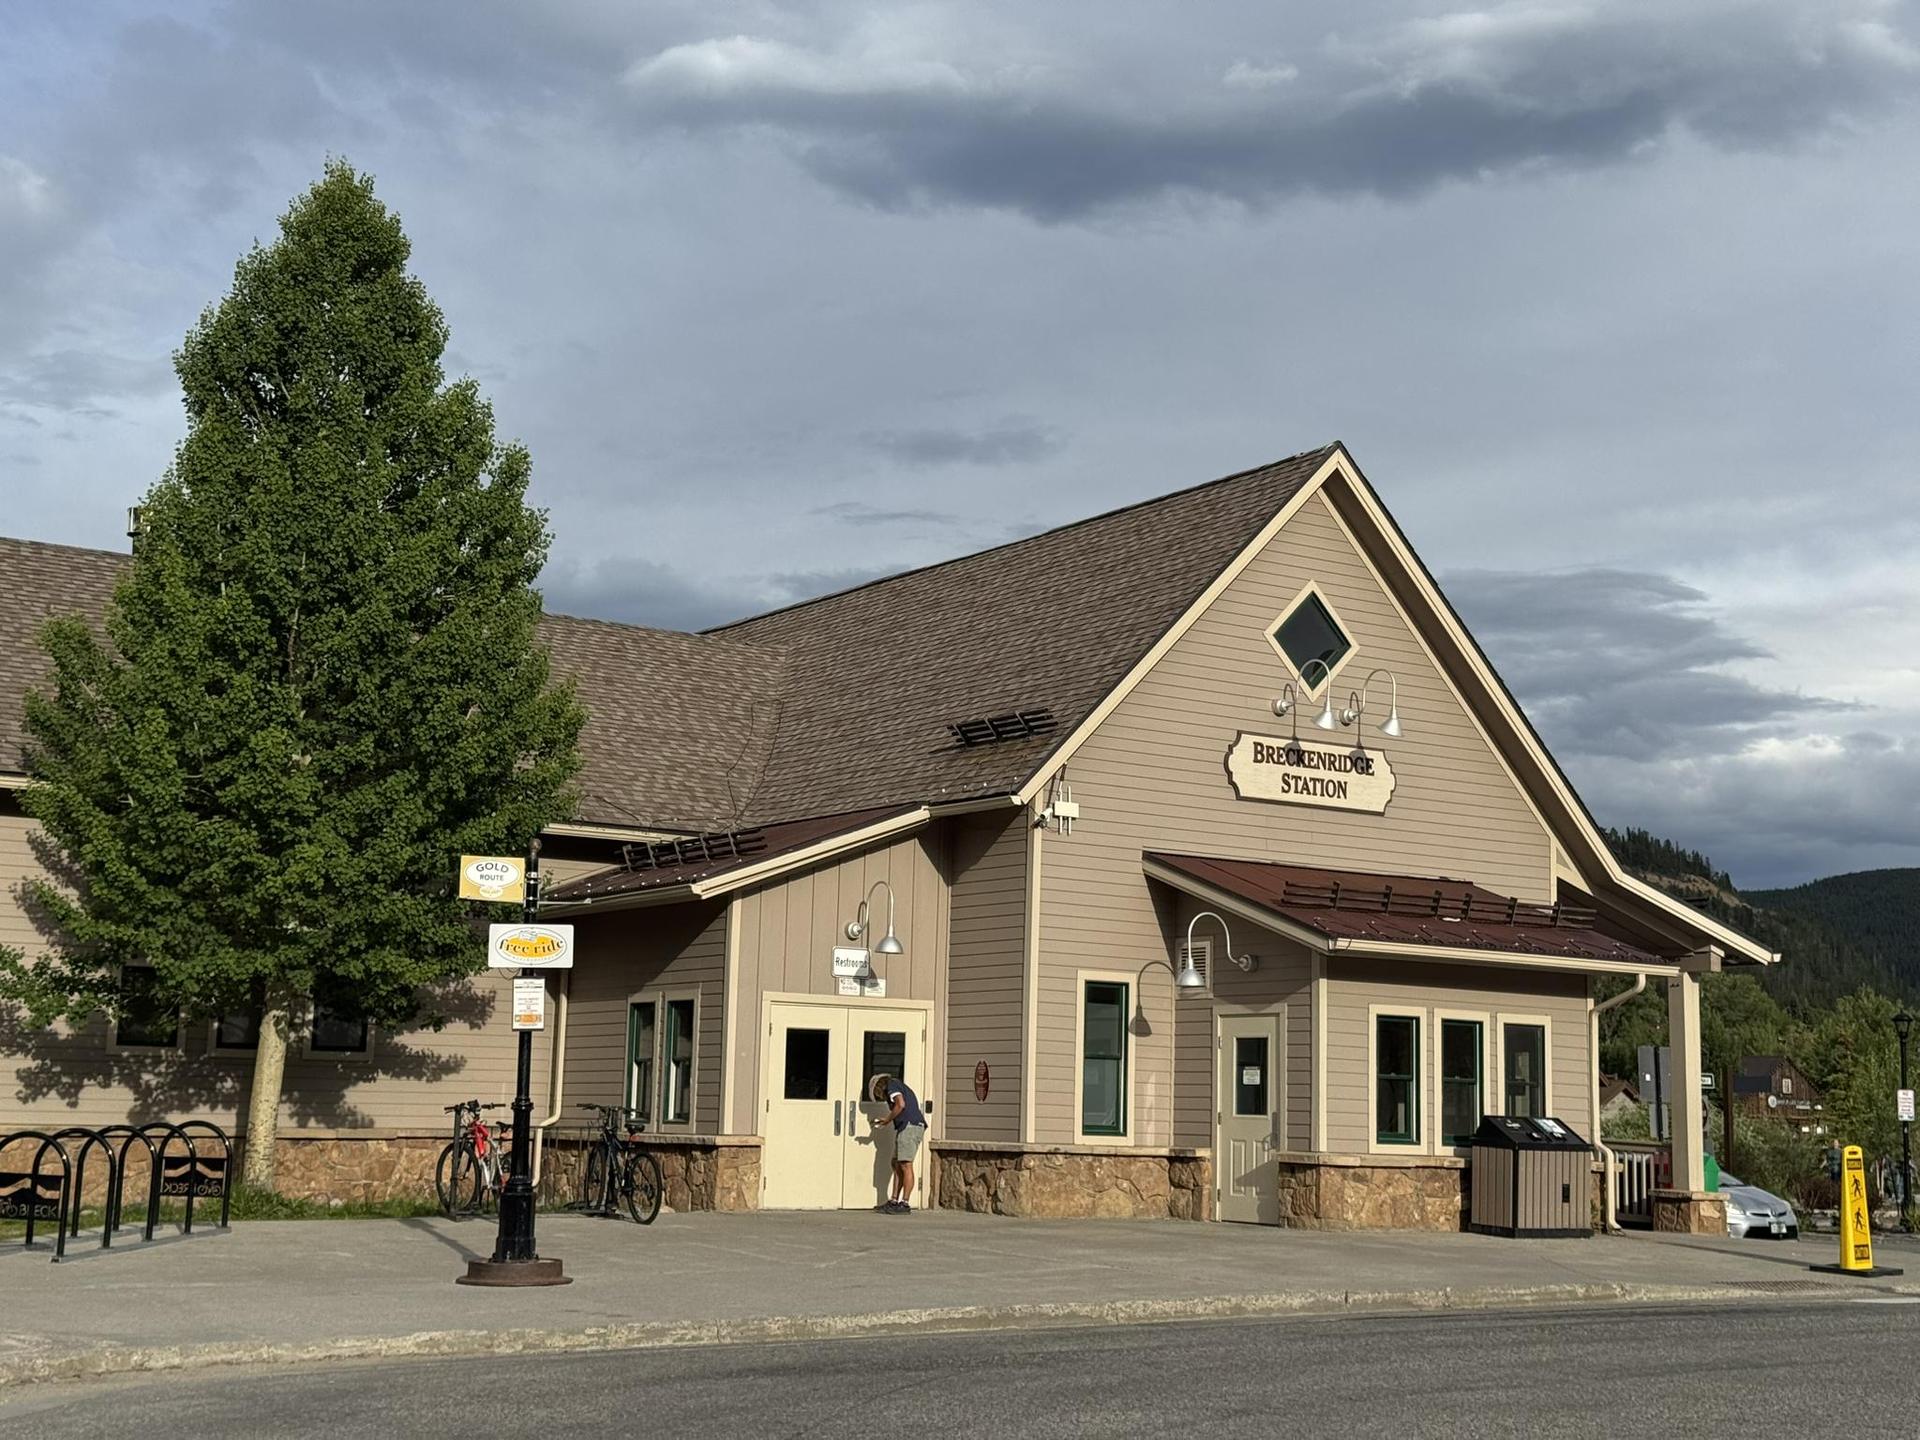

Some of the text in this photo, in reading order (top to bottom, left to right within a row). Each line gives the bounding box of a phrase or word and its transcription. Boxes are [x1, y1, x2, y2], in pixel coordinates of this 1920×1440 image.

[1253, 741, 1375, 776] BRECKENRIDGE
[1281, 772, 1348, 800] STATION
[476, 862, 509, 874] GOLD
[480, 874, 504, 882] ROUTE
[19, 1203, 57, 1218] BECK
